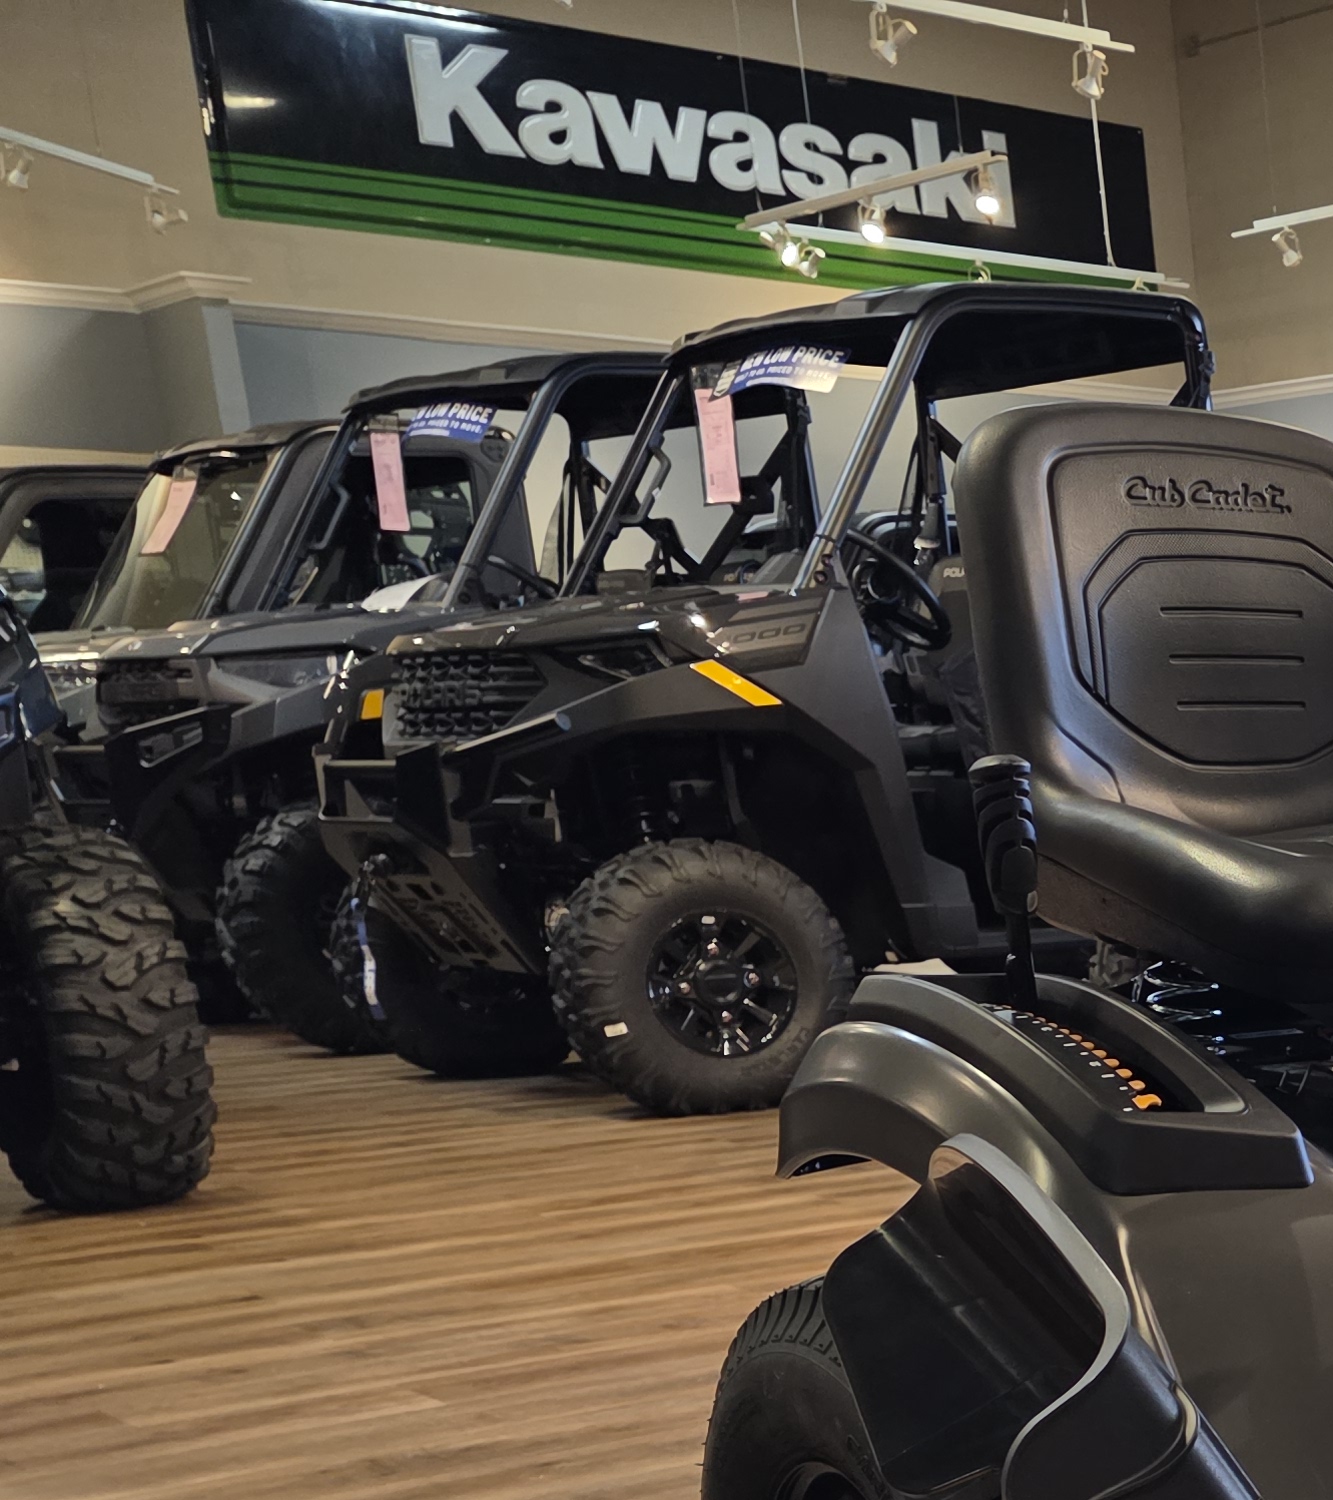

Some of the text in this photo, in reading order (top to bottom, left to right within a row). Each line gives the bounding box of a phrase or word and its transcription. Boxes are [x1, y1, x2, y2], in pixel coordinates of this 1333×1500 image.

[404, 33, 1017, 229] Kawasaki
[791, 346, 845, 369] PRICE
[448, 403, 493, 424] PRICE
[1122, 475, 1186, 508] Cub
